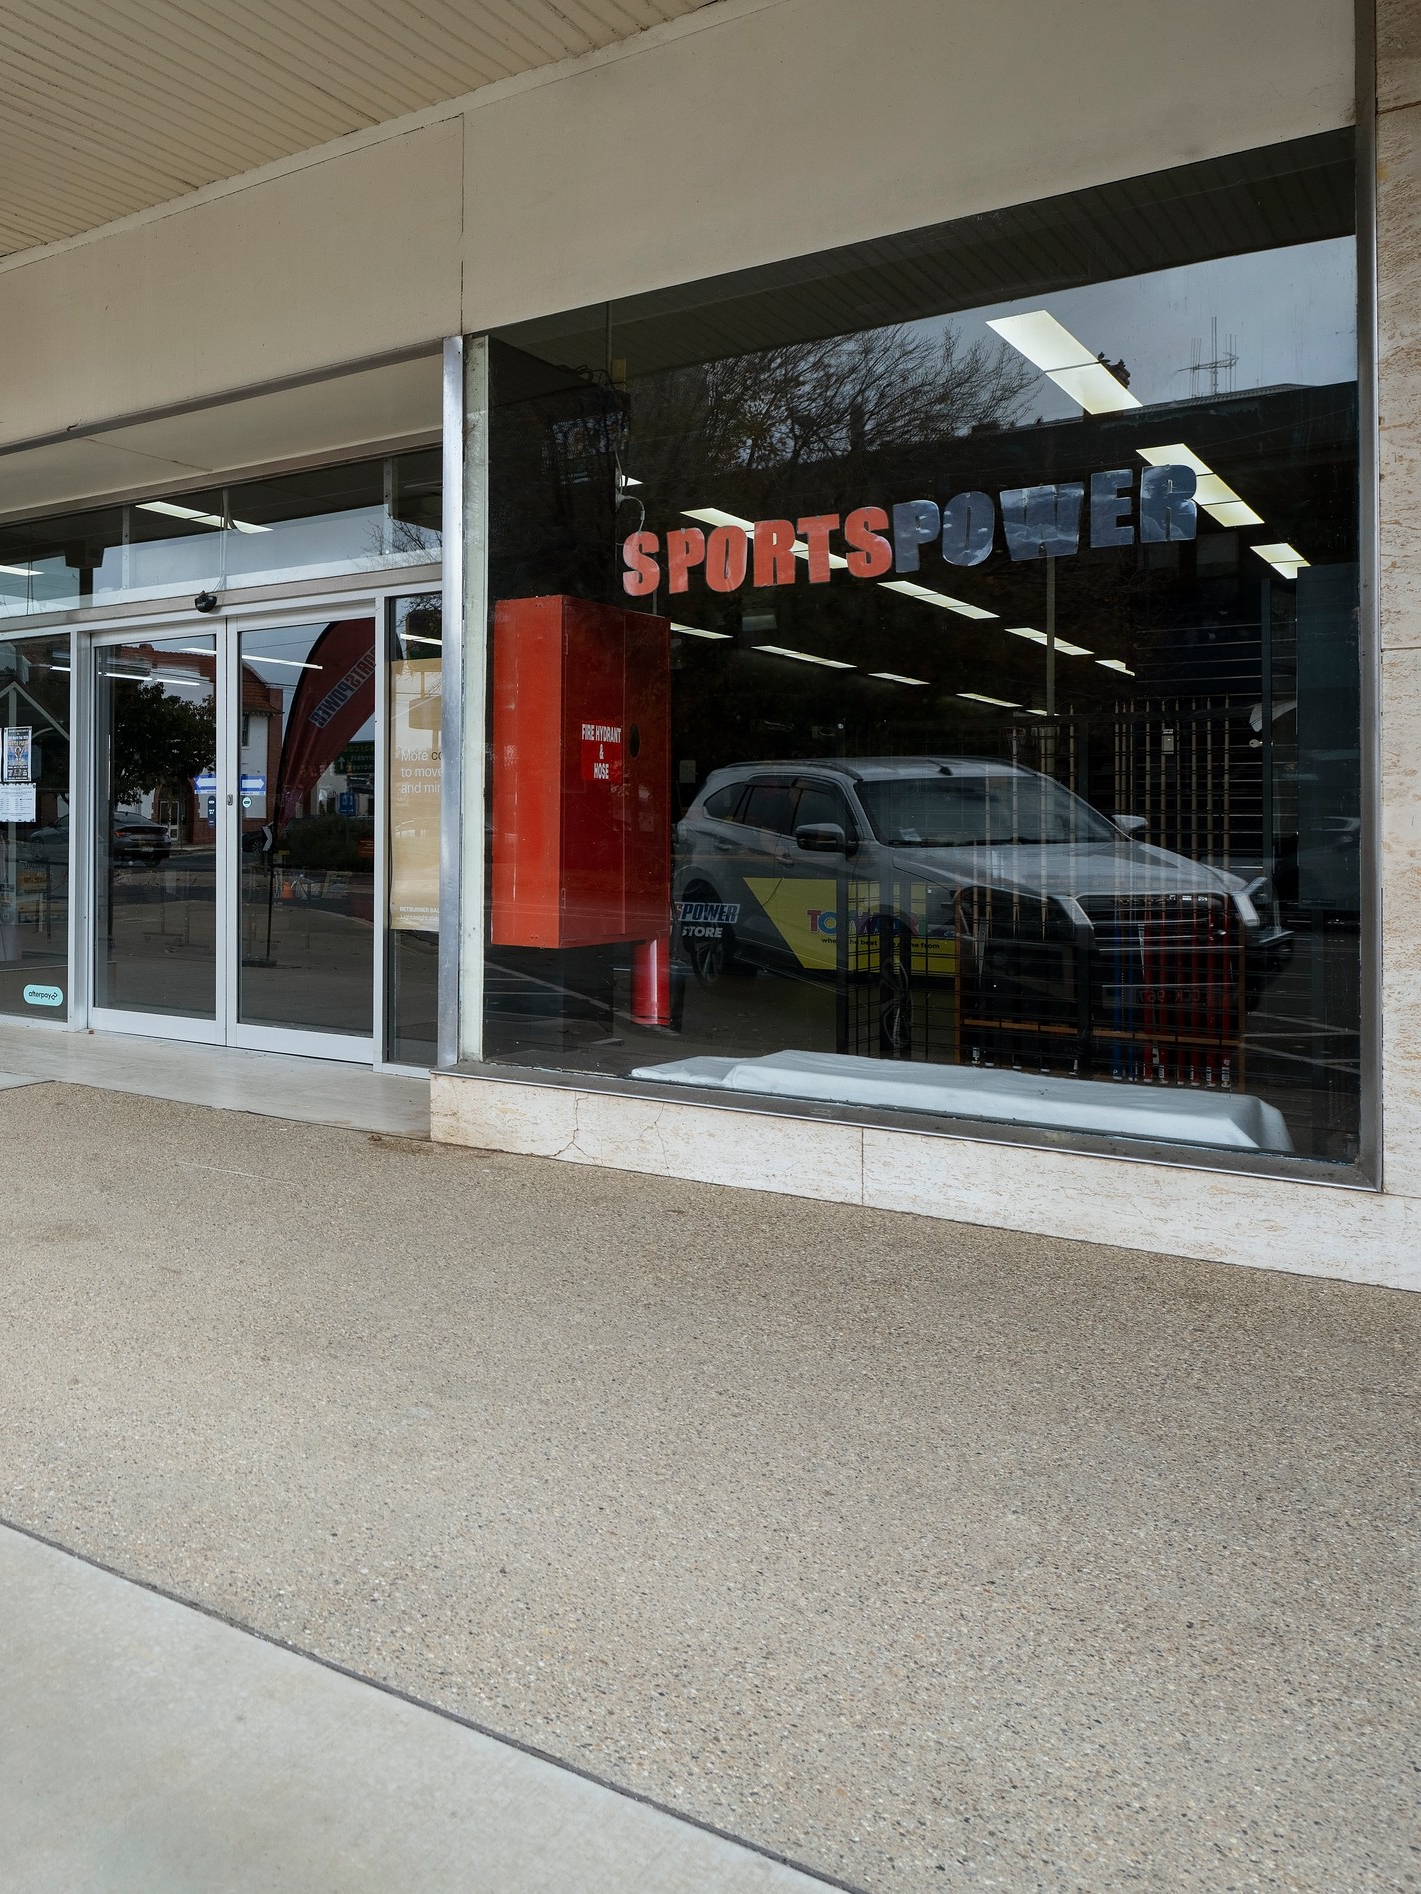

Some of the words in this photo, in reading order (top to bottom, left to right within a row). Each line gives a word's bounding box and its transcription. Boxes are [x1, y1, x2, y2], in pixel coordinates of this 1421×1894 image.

[622, 464, 1197, 597] SPORTSPOWER
[582, 723, 594, 740] FIRE
[596, 725, 621, 743] HYDRANT
[401, 750, 428, 761] More
[599, 743, 604, 760] &
[401, 767, 411, 777] to
[593, 763, 609, 779] HOSE
[401, 782, 422, 793] and
[28, 990, 51, 999] afterpay
